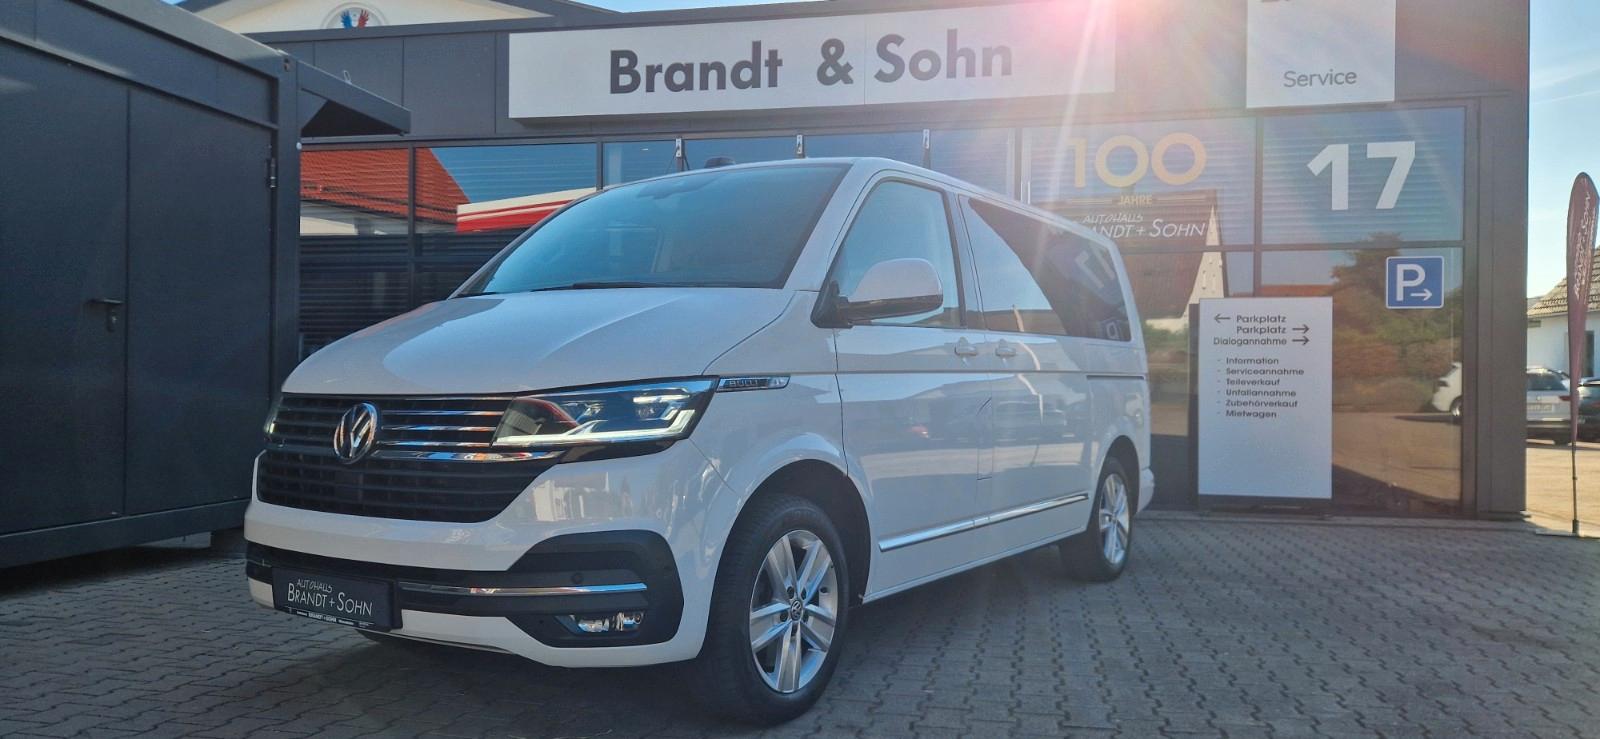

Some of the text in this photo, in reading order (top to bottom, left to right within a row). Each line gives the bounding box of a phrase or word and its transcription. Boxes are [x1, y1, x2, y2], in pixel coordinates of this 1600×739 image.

[609, 28, 1012, 94] Brandt & Sohn
[1283, 68, 1357, 88] Service
[1068, 132, 1207, 188] 100
[1307, 141, 1416, 210] 17
[1118, 193, 1153, 207] JAHRE
[1083, 212, 1144, 224] AUTOHAUS
[1149, 219, 1207, 238] SOHN
[1397, 264, 1425, 302] P
[1236, 314, 1287, 324] Parkplatz
[1236, 325, 1287, 335] Parkplatz
[1213, 337, 1287, 347] Dialogannahme
[1226, 357, 1279, 365] Information
[1226, 367, 1304, 376] Serviceannahme
[1226, 378, 1280, 386] Teileverkauf
[1226, 389, 1297, 397] Unfallannahme
[1225, 399, 1298, 408] Zubehörverkauf
[1226, 410, 1277, 419] Mietwagen
[297, 579, 333, 593] AUTOHAUS
[288, 583, 373, 616] BRANDT + SOHN
